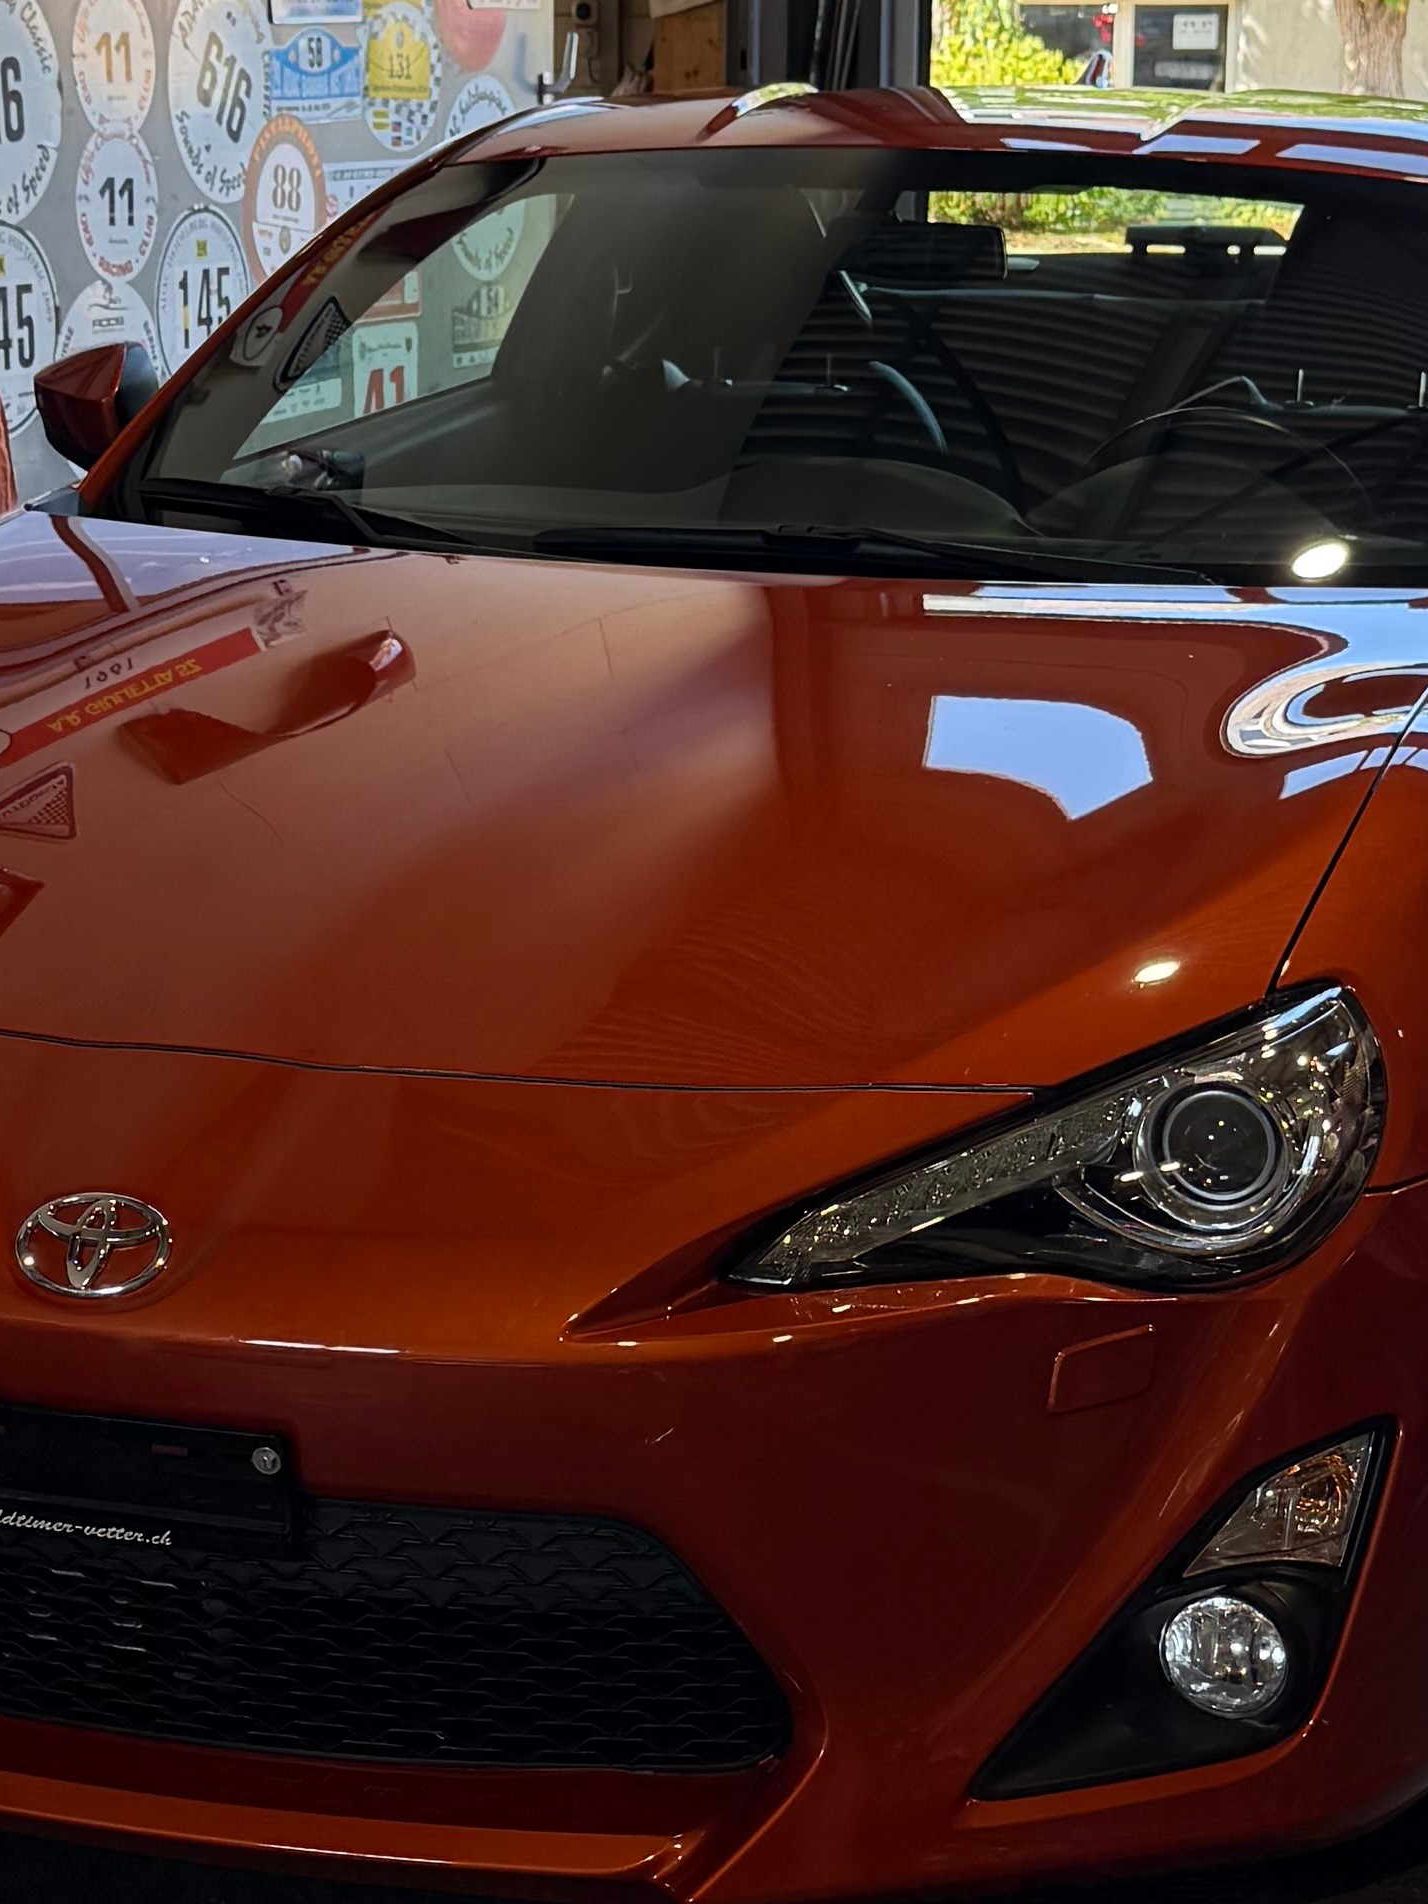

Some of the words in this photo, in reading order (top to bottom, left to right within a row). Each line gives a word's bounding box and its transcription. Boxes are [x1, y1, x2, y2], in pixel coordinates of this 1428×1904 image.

[94, 31, 133, 84] 11
[196, 30, 253, 144] 616
[6, 183, 20, 215] of
[21, 143, 51, 204] Speed
[98, 176, 135, 227] 11
[272, 164, 302, 213] 88
[178, 266, 231, 350] 145
